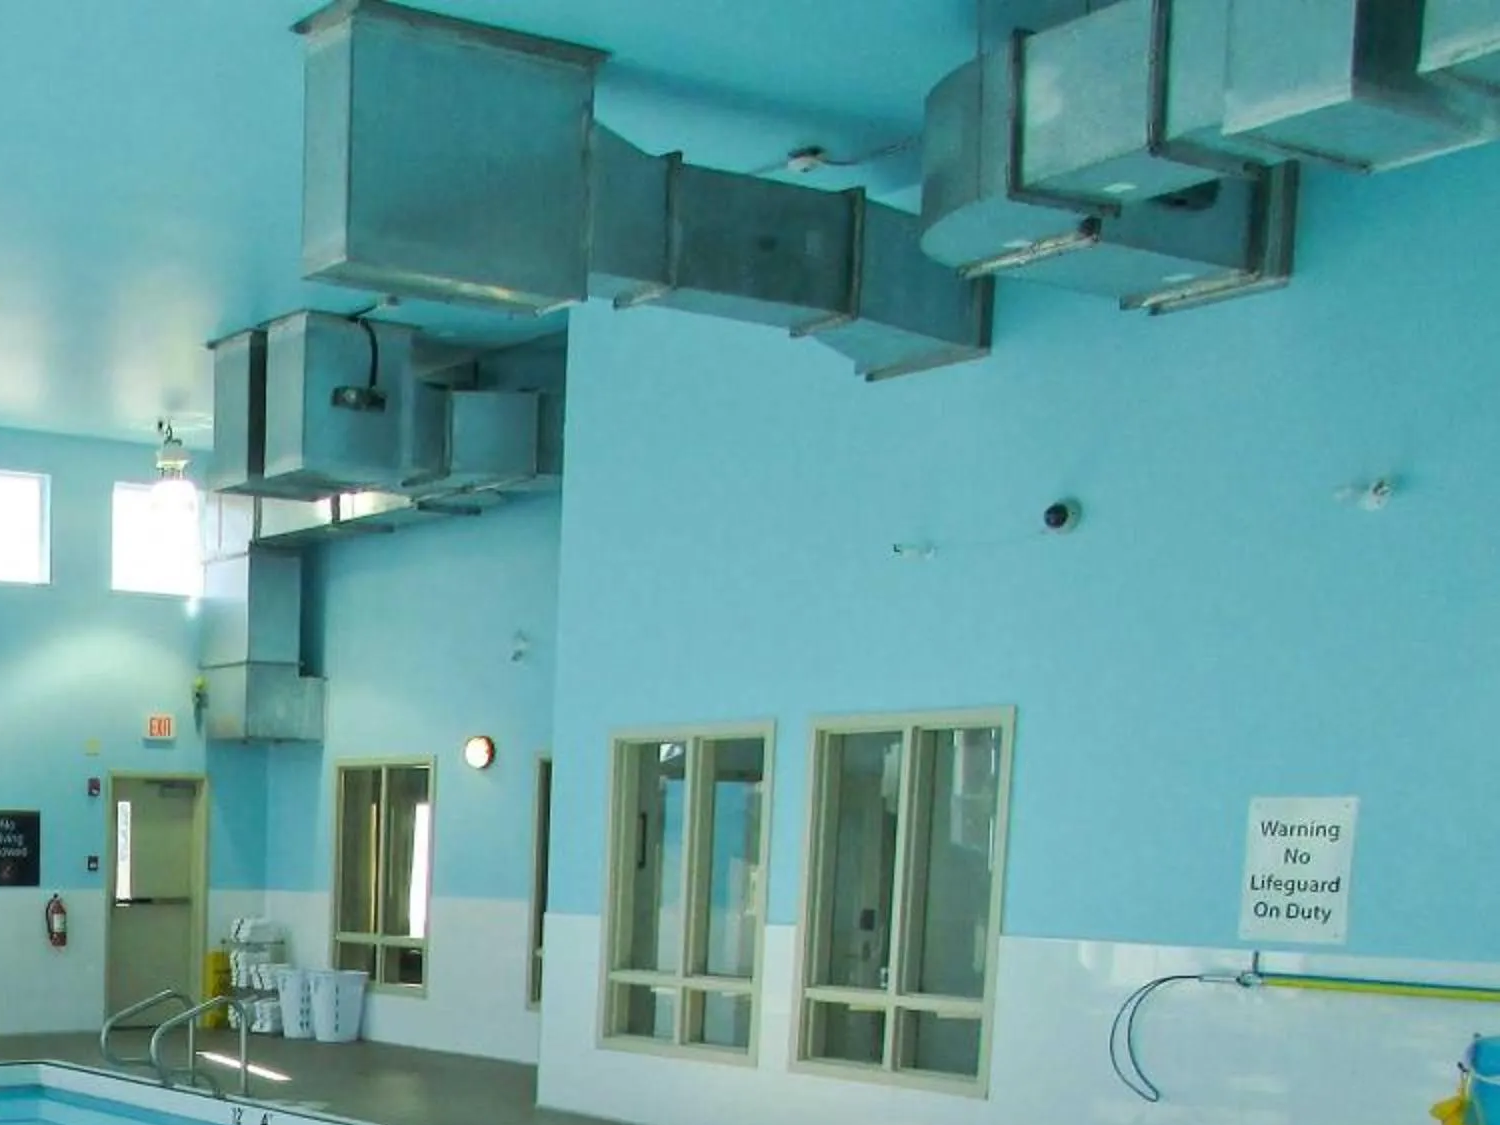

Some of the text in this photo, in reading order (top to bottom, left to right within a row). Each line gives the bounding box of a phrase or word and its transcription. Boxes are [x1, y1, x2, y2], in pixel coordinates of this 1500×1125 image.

[149, 717, 171, 737] EXIT
[0, 819, 16, 831] No
[1261, 820, 1340, 842] Warning
[1284, 848, 1311, 865] No
[1251, 875, 1341, 897] Lifeguard
[1254, 901, 1331, 924] On Duty
